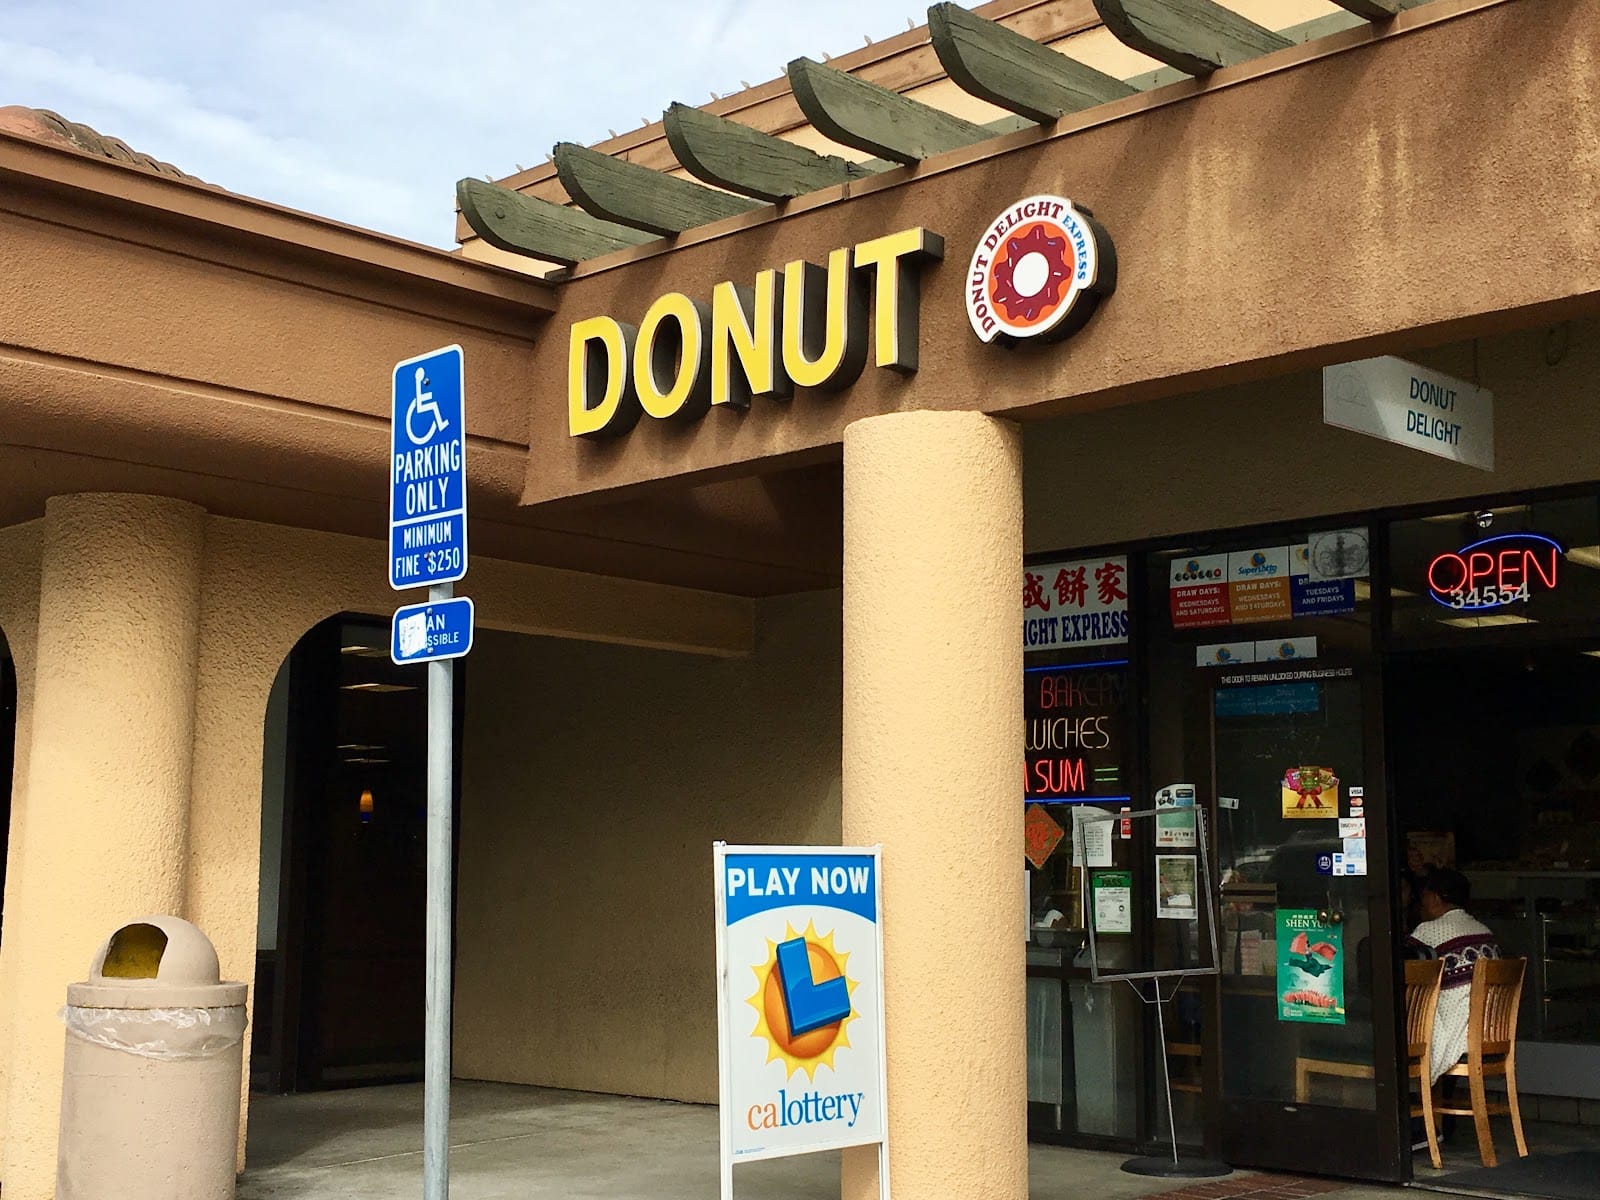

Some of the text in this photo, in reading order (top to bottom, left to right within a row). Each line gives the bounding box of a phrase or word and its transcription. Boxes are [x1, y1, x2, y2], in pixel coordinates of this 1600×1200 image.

[972, 201, 1088, 333] DONUT DELIGHT EXPRESS
[568, 226, 924, 437] DONUT
[1409, 376, 1457, 413] DONUT
[1406, 409, 1462, 446] DELIGHT
[395, 439, 460, 484] PARKING
[405, 477, 449, 516] ONLY
[403, 520, 452, 550] MINIMUM
[395, 547, 460, 579] FINE $250
[1428, 547, 1557, 594] OPEN
[1176, 589, 1197, 598] DRAW
[1236, 583, 1257, 592] DRAW
[1302, 594, 1345, 605] AND FRIDAYS
[1305, 586, 1340, 596] TUESDAYS
[1450, 582, 1530, 609] 34554
[1062, 610, 1128, 642] EXPRESS
[1176, 605, 1225, 617] AND SATURDAYS
[1034, 758, 1085, 793] SUM
[727, 866, 869, 897] PLAY NOW
[1285, 918, 1310, 928] SHEN
[747, 1089, 863, 1131] calottery
